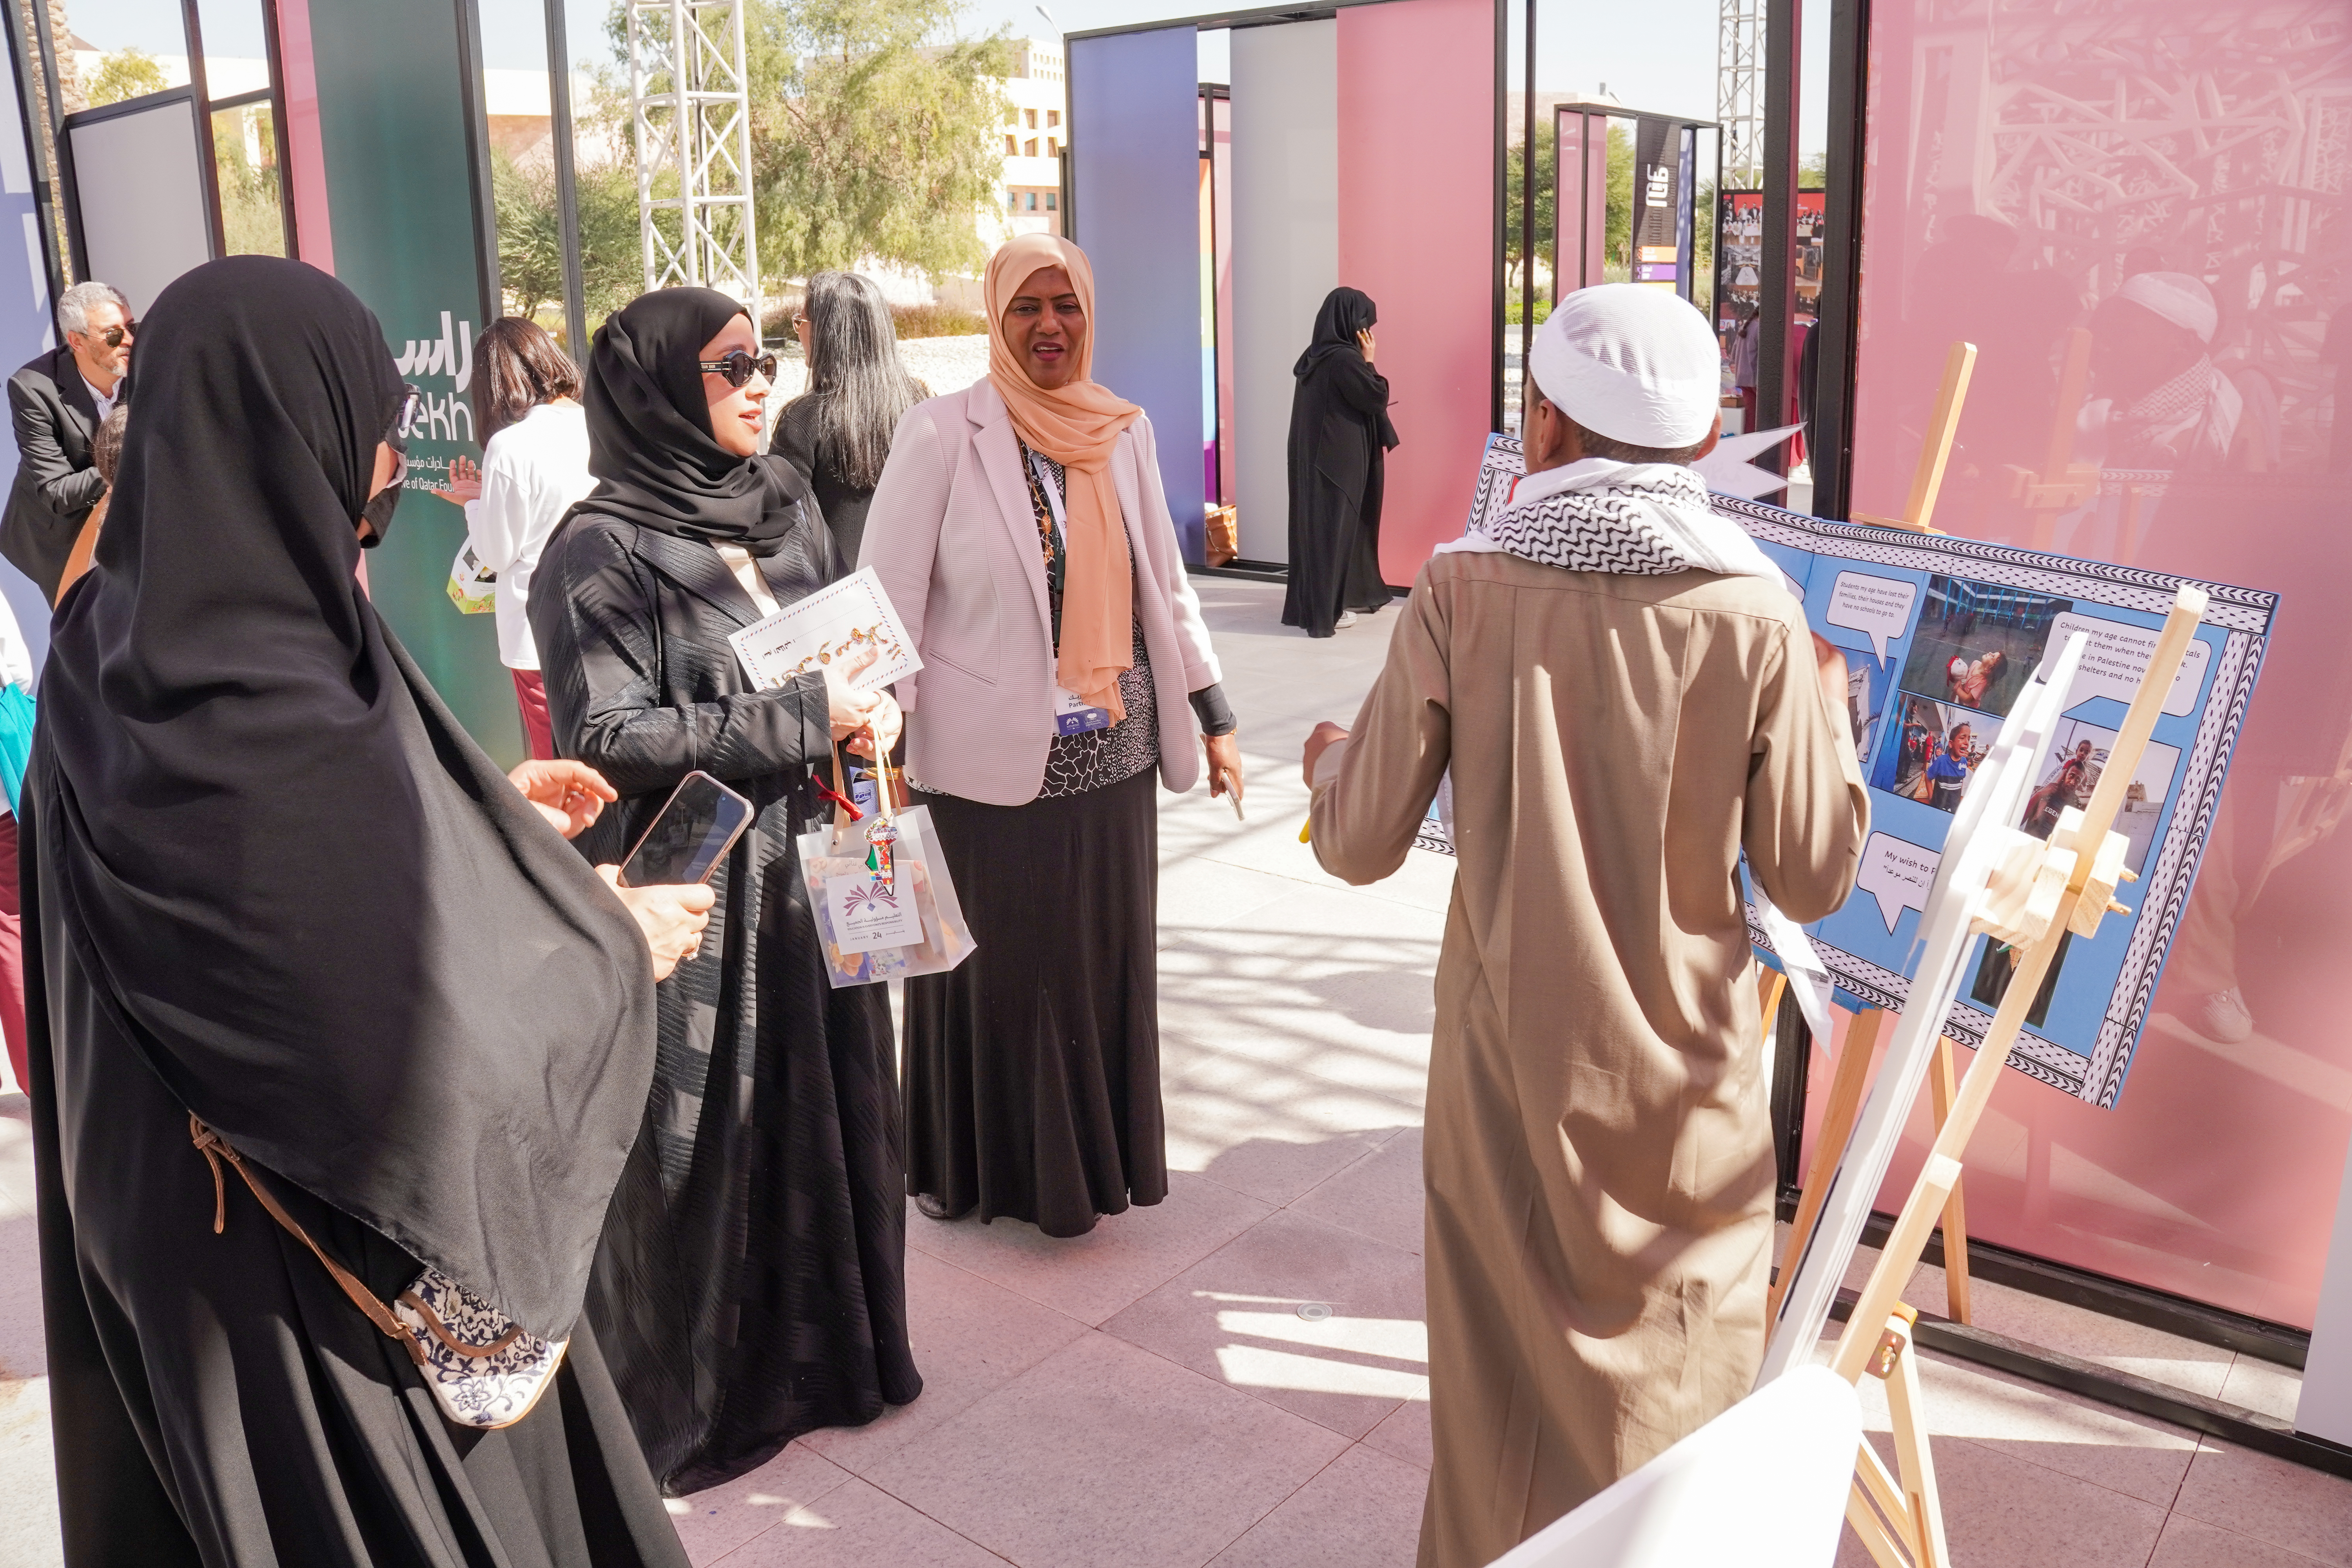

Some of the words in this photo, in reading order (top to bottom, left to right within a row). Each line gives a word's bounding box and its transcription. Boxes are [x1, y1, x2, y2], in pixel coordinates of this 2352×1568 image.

[393, 311, 473, 393] راس
[411, 477, 418, 489] of
[419, 477, 438, 490] Qatar
[1840, 581, 1859, 590] Students
[1839, 591, 1857, 600] families,
[1869, 597, 1884, 605] houses
[2060, 622, 2089, 633] Children
[2092, 630, 2103, 638] my
[2120, 635, 2146, 646] cannot
[2094, 641, 2112, 651] them
[2115, 646, 2135, 656] when
[2097, 656, 2131, 670] Palestine
[2078, 664, 2107, 676] shelters
[2108, 671, 2123, 680] and
[1884, 850, 1898, 862] My
[1899, 857, 1918, 868] wish
[1920, 864, 1929, 872] to
[846, 918, 863, 927] الجميع
[885, 912, 902, 920] التعليم
